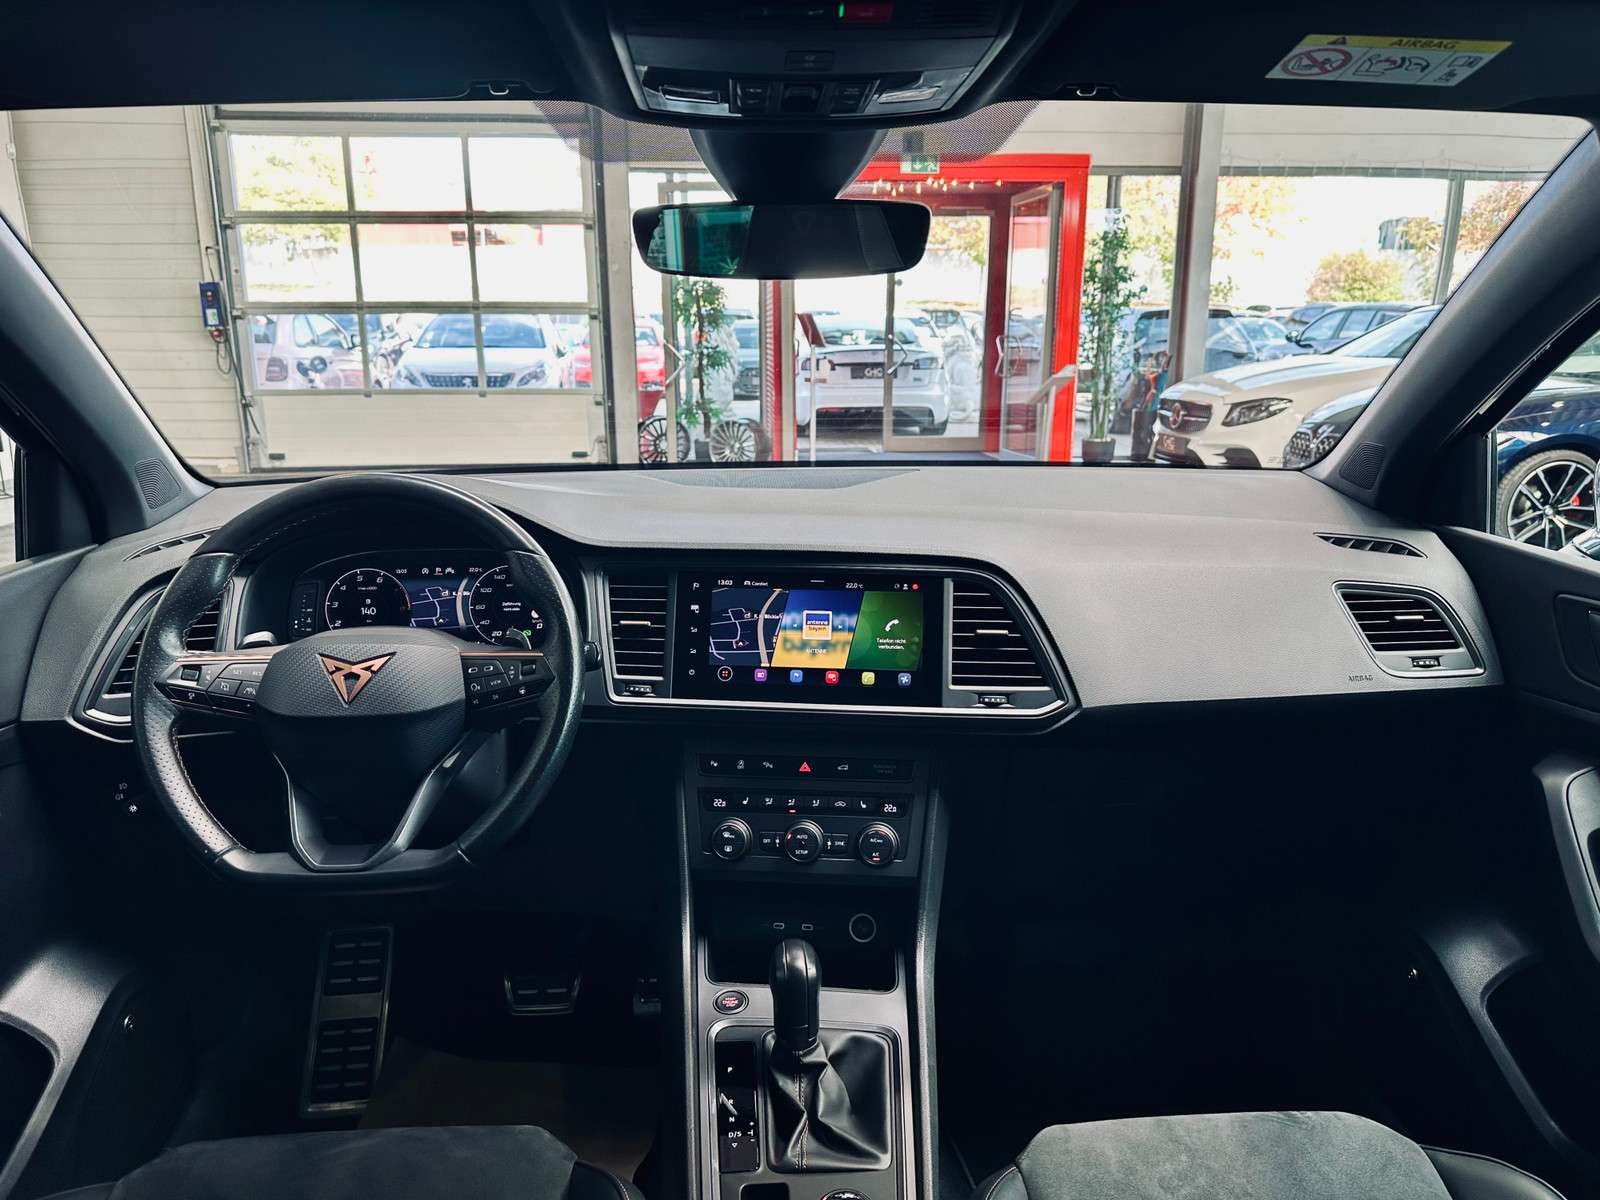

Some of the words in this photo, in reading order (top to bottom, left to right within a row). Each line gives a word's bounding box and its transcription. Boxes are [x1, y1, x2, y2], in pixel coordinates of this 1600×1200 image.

[1390, 38, 1458, 49] AIRBAG
[361, 606, 376, 615] 140
[1348, 674, 1374, 682] AIRBAG
[728, 1130, 742, 1138] D/S
